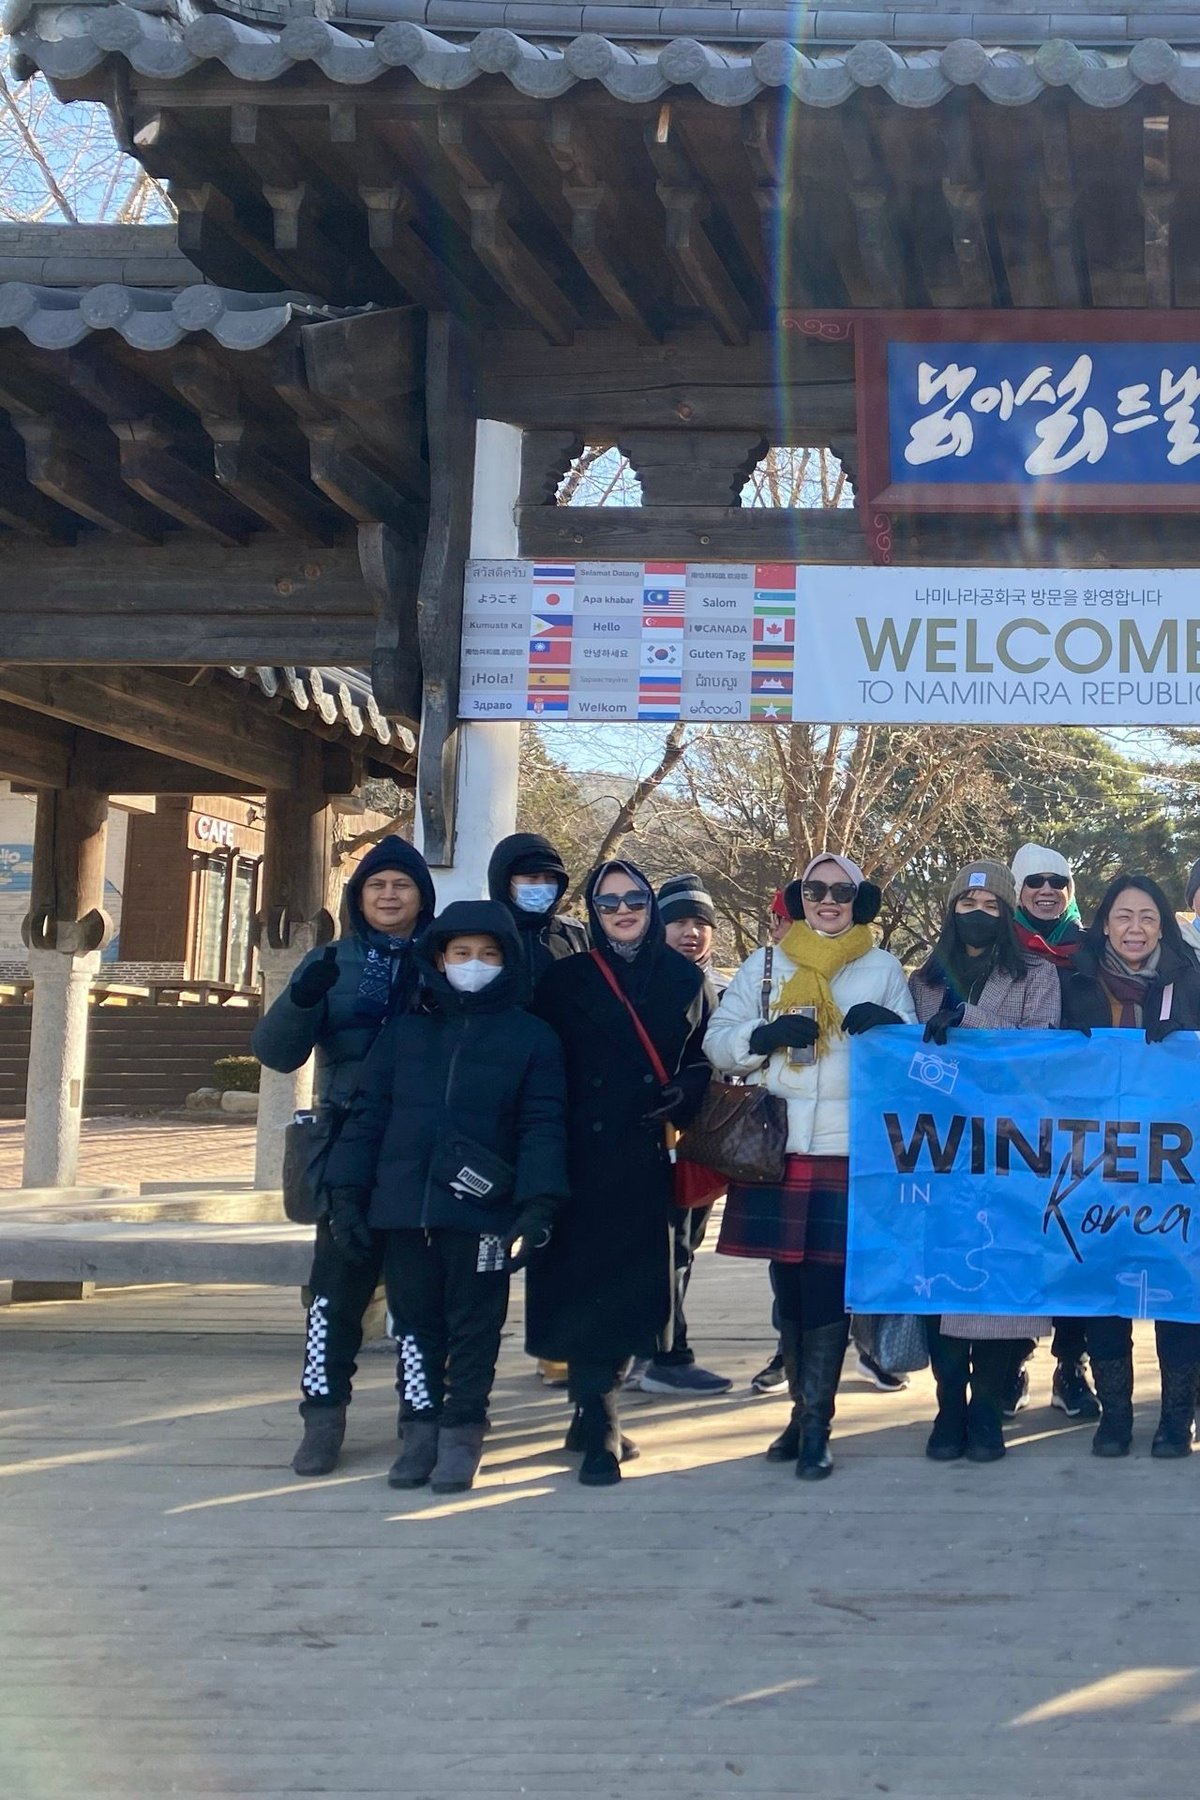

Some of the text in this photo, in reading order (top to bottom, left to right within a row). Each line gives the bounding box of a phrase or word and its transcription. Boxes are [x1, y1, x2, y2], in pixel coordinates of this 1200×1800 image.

[580, 569, 639, 578] Selamat Datang
[478, 593, 518, 604] ようこそ
[583, 595, 634, 605] Apa khabar
[702, 597, 737, 608] Salom
[915, 588, 1163, 606] 나미나라공화국 방문을 환영합니다
[469, 621, 523, 629] Kumusta Ka
[593, 622, 621, 631] Hello
[583, 648, 628, 658] 안녕하세요
[689, 649, 746, 661] Guten Tag
[471, 673, 514, 686] ¡Hola!
[858, 680, 894, 704] TO
[904, 680, 1072, 704] NAMINARA
[472, 700, 512, 711] Здраво
[579, 702, 627, 712] Welkom
[196, 816, 235, 848] CAFE
[883, 1112, 1196, 1184] WINTER
[459, 1169, 490, 1192] PUMA
[901, 1183, 931, 1204] IN
[1043, 1152, 1192, 1263] Korea
